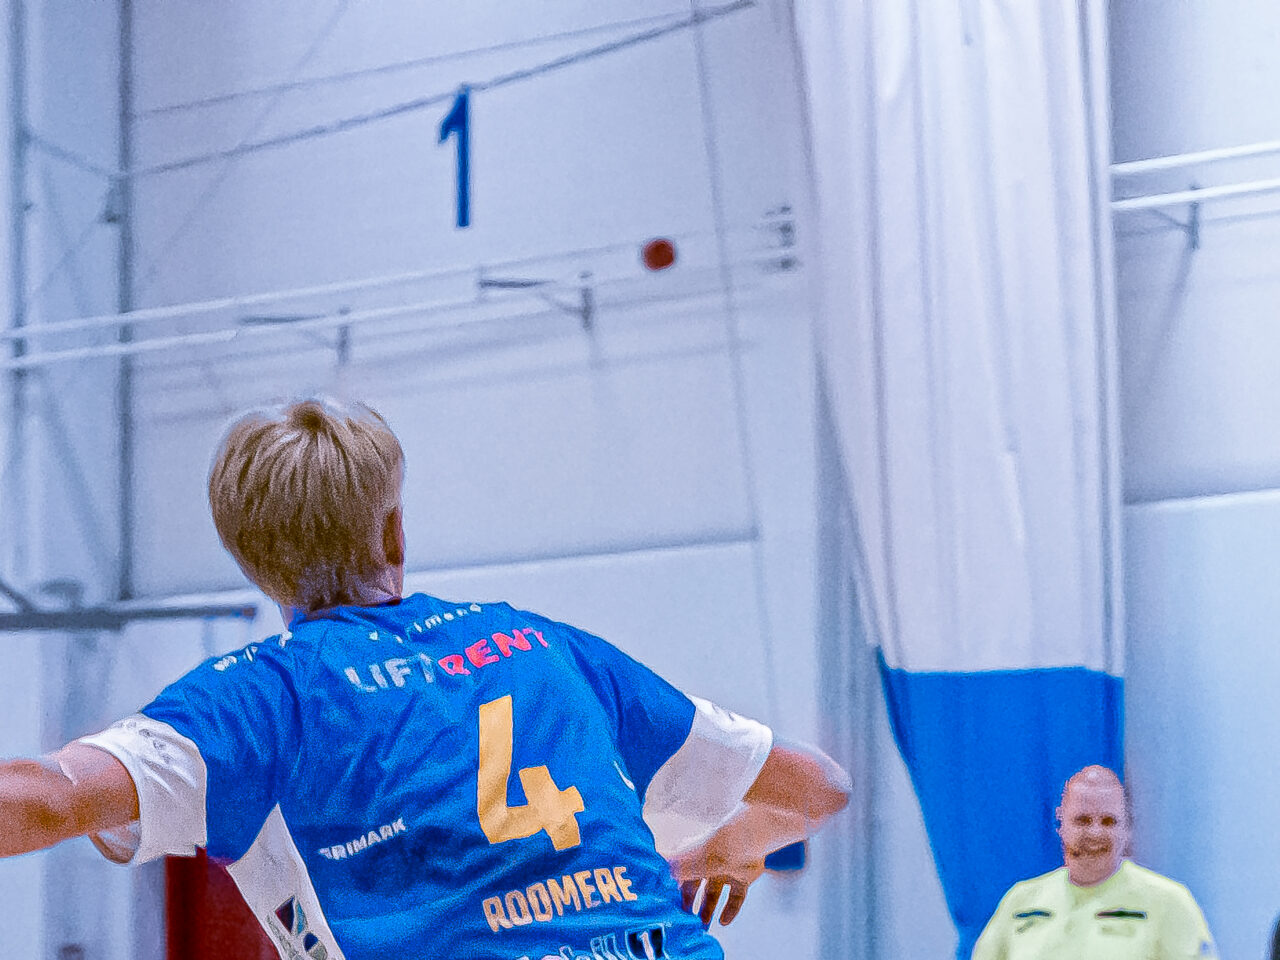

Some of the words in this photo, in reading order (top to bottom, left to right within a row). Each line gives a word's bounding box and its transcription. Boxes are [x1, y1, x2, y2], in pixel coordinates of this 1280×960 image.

[438, 85, 470, 228] 1
[477, 694, 586, 852] 4
[482, 866, 638, 933] ROOMERE
